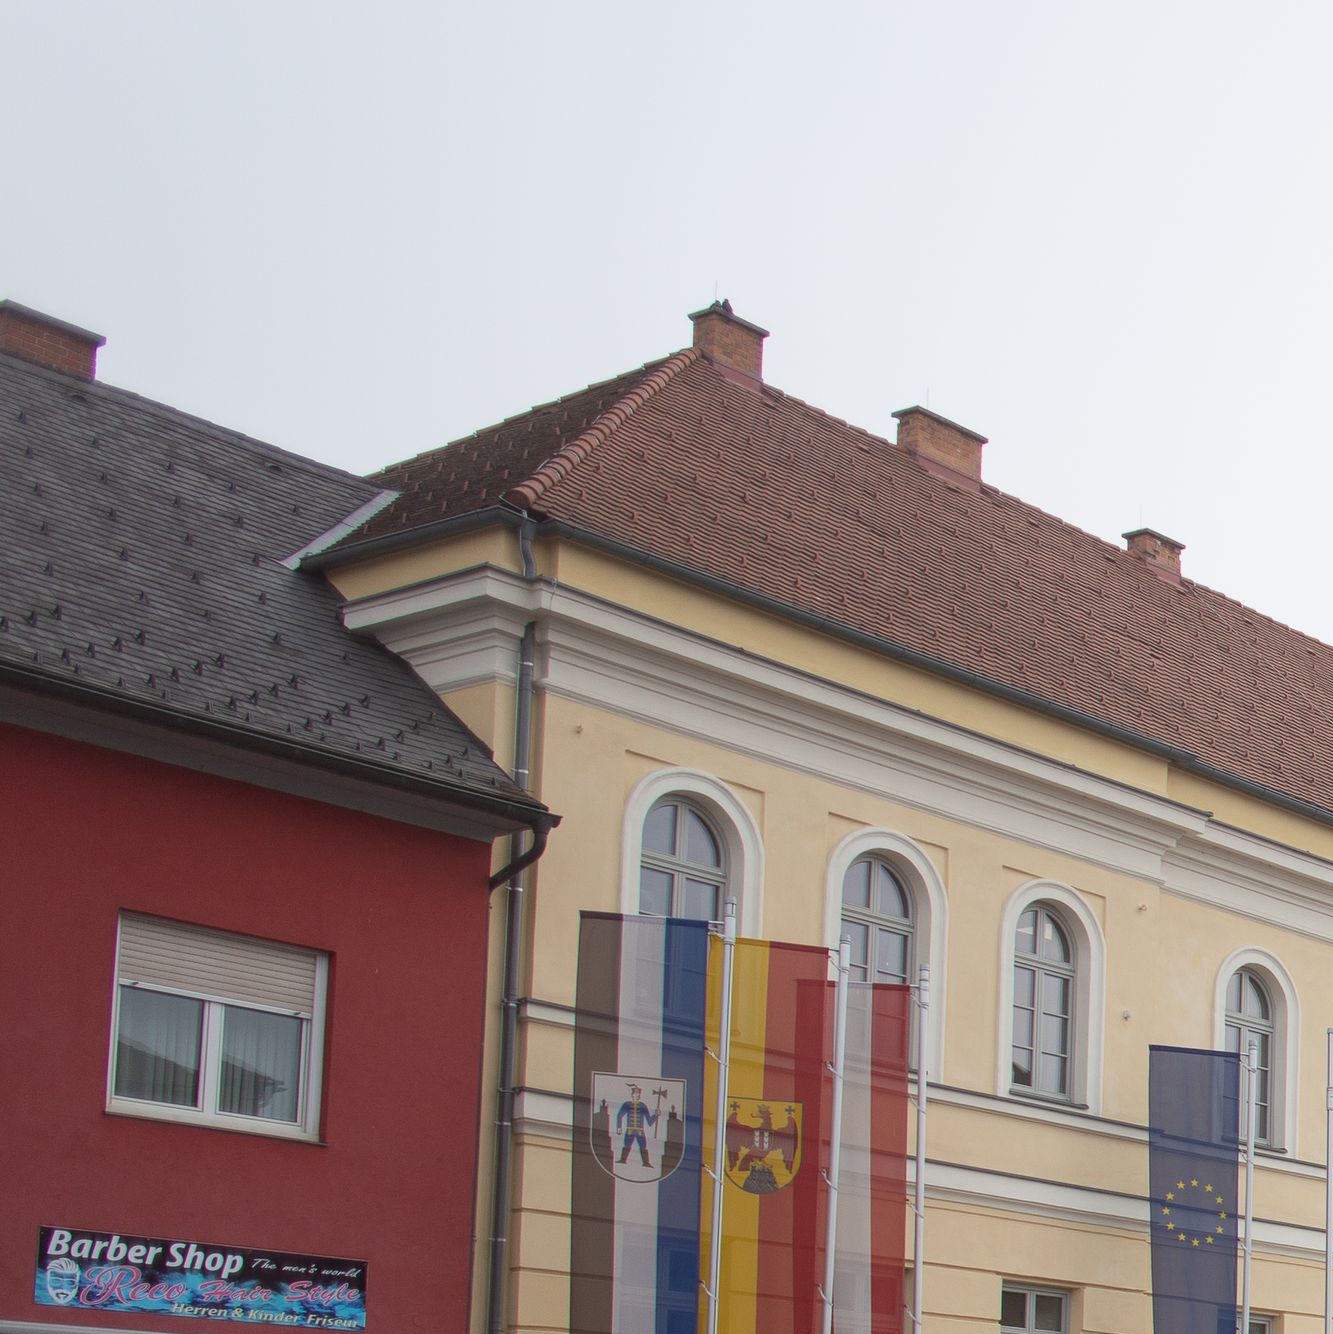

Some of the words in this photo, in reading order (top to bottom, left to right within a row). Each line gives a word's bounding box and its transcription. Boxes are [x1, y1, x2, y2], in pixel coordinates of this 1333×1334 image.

[47, 1230, 162, 1265] Barber
[166, 1243, 243, 1279] Shop
[250, 1258, 277, 1271] The
[282, 1263, 316, 1275] men's
[321, 1267, 361, 1279] world
[80, 1265, 186, 1305] Reco
[199, 1280, 272, 1302] Hair
[284, 1280, 360, 1303] Style
[172, 1302, 227, 1317] Herren
[231, 1307, 243, 1318] &
[248, 1308, 300, 1323] Kinder
[306, 1313, 359, 1328] Friseur
